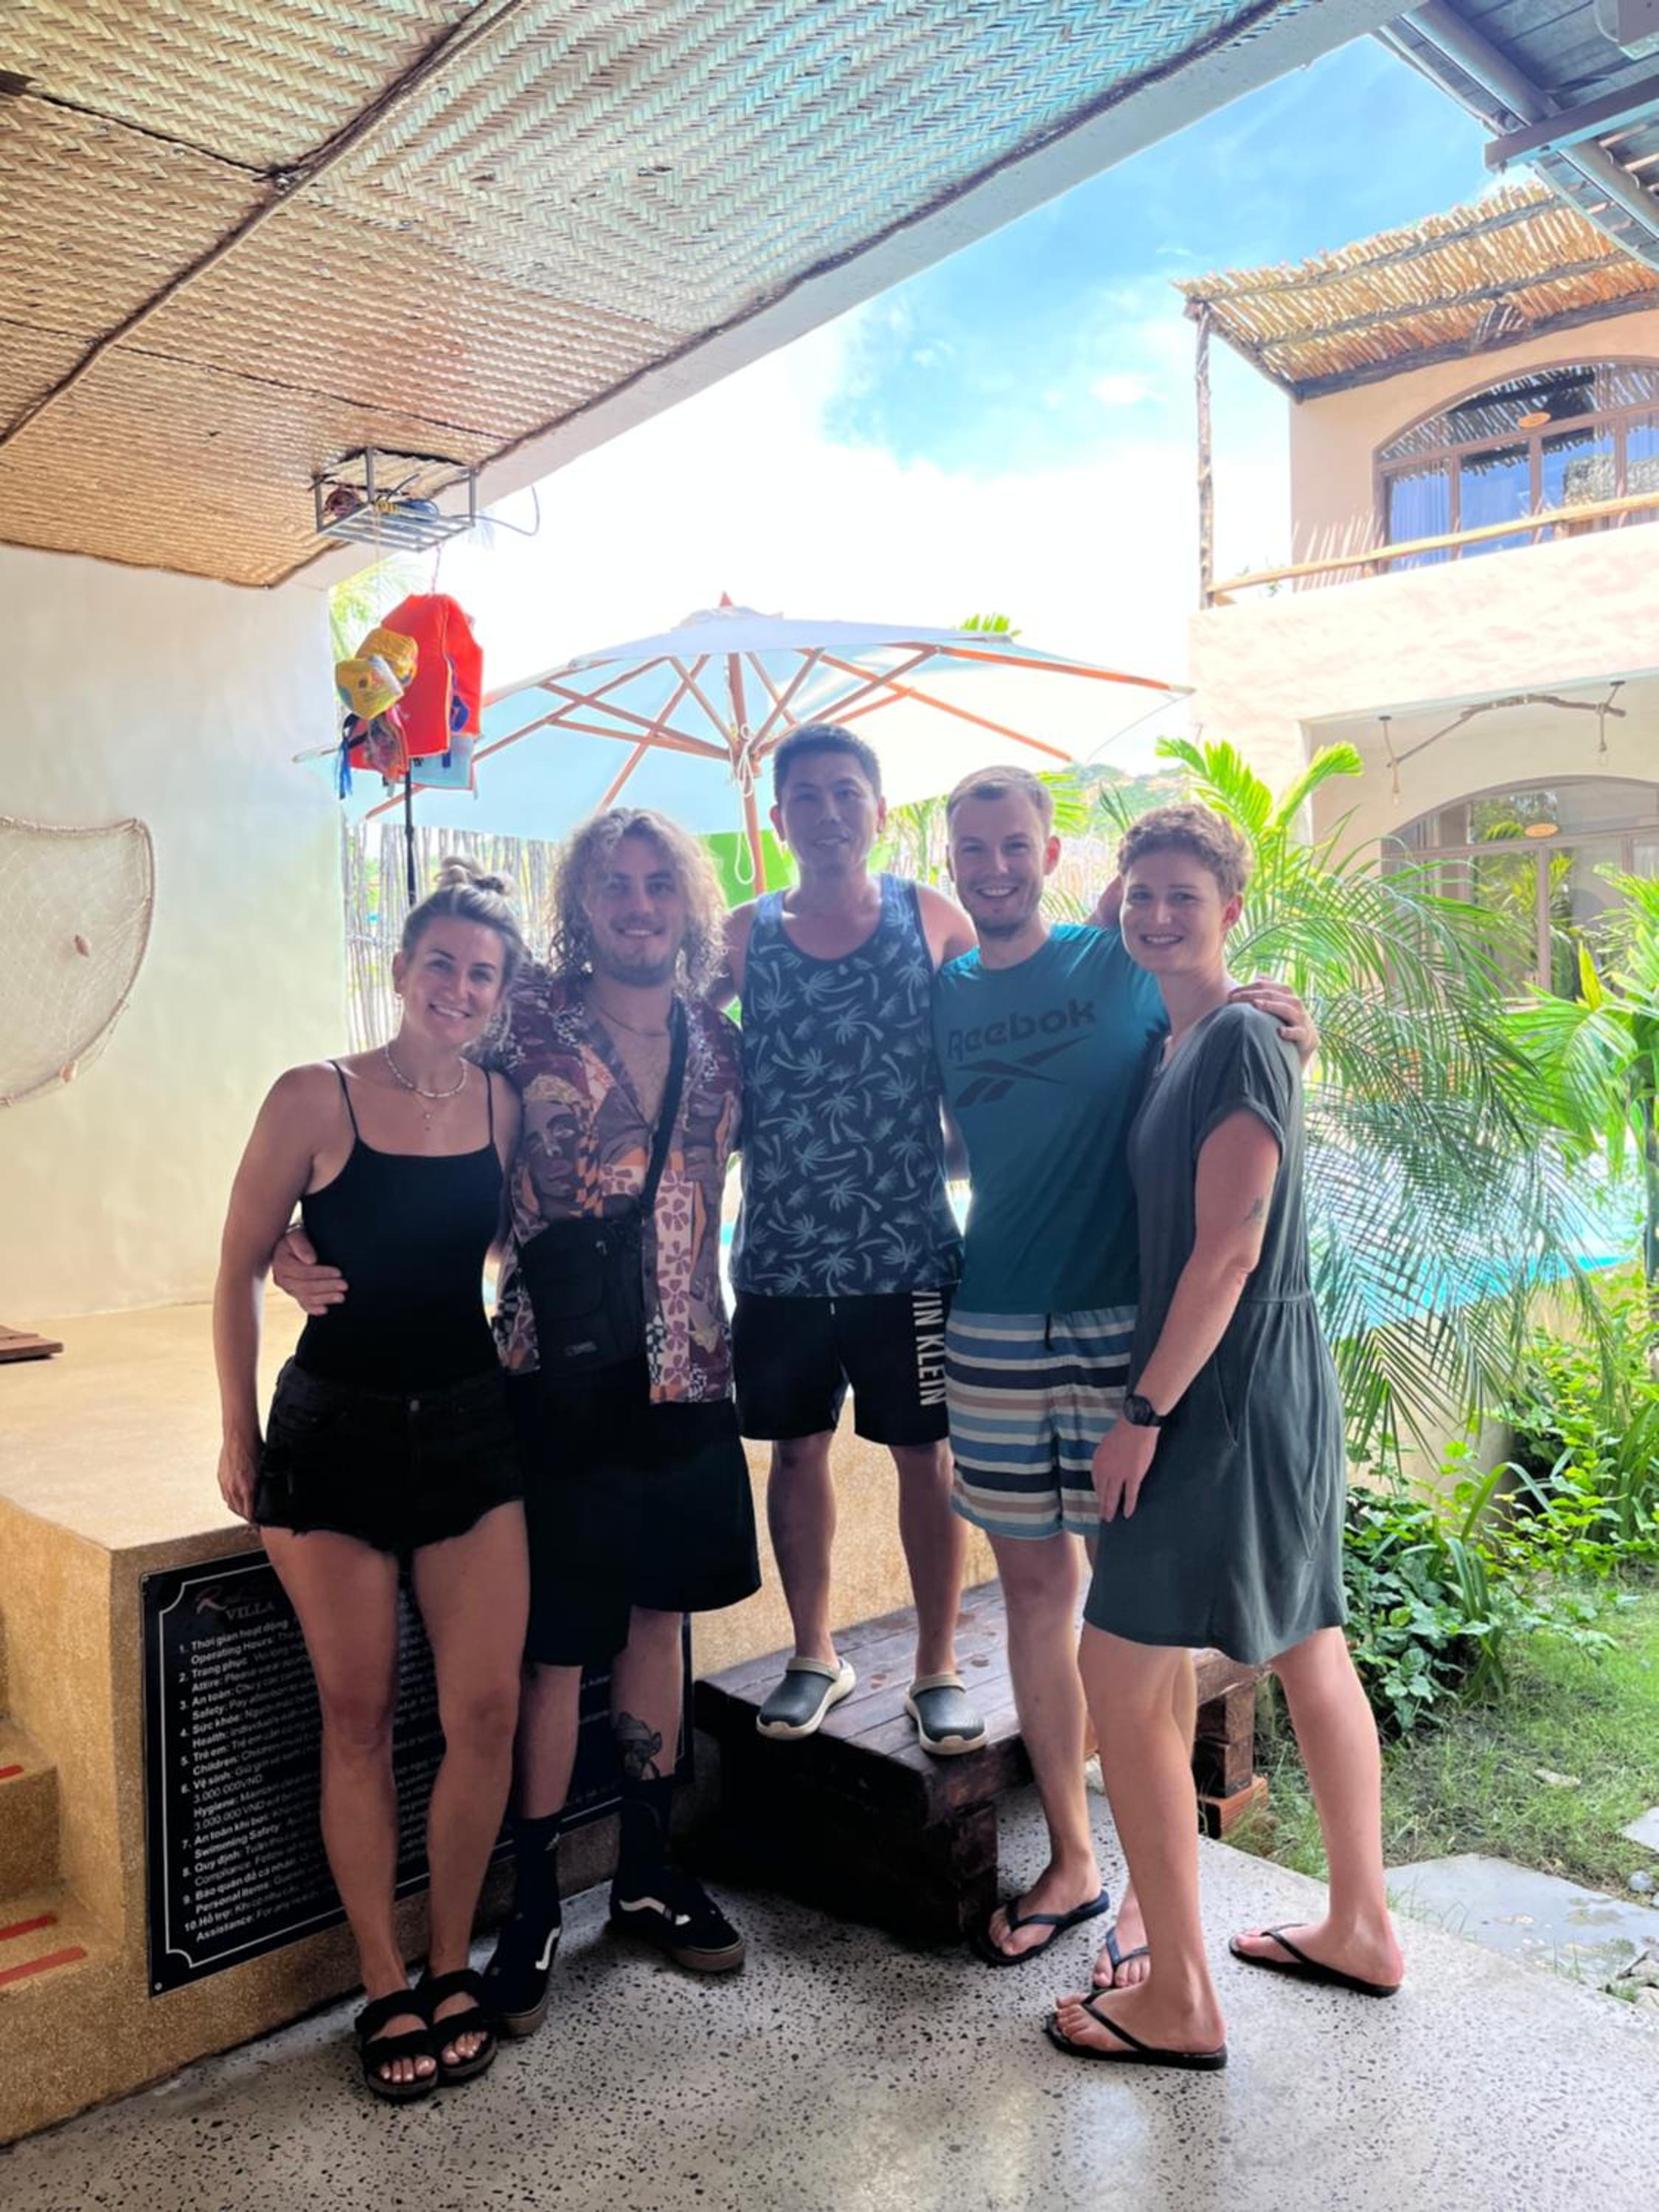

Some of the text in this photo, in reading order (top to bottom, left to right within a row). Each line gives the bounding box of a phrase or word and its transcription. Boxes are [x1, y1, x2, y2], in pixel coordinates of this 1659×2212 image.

[916, 1334, 947, 1405] KLEIN
[226, 1602, 274, 1621] VILLA
[190, 1646, 241, 1664] Operating
[192, 1697, 206, 1706] An
[192, 1757, 237, 1775] Children:
[194, 1835, 209, 1845] An
[195, 1836, 247, 1859] Swimming
[195, 1891, 240, 1913] Personal
